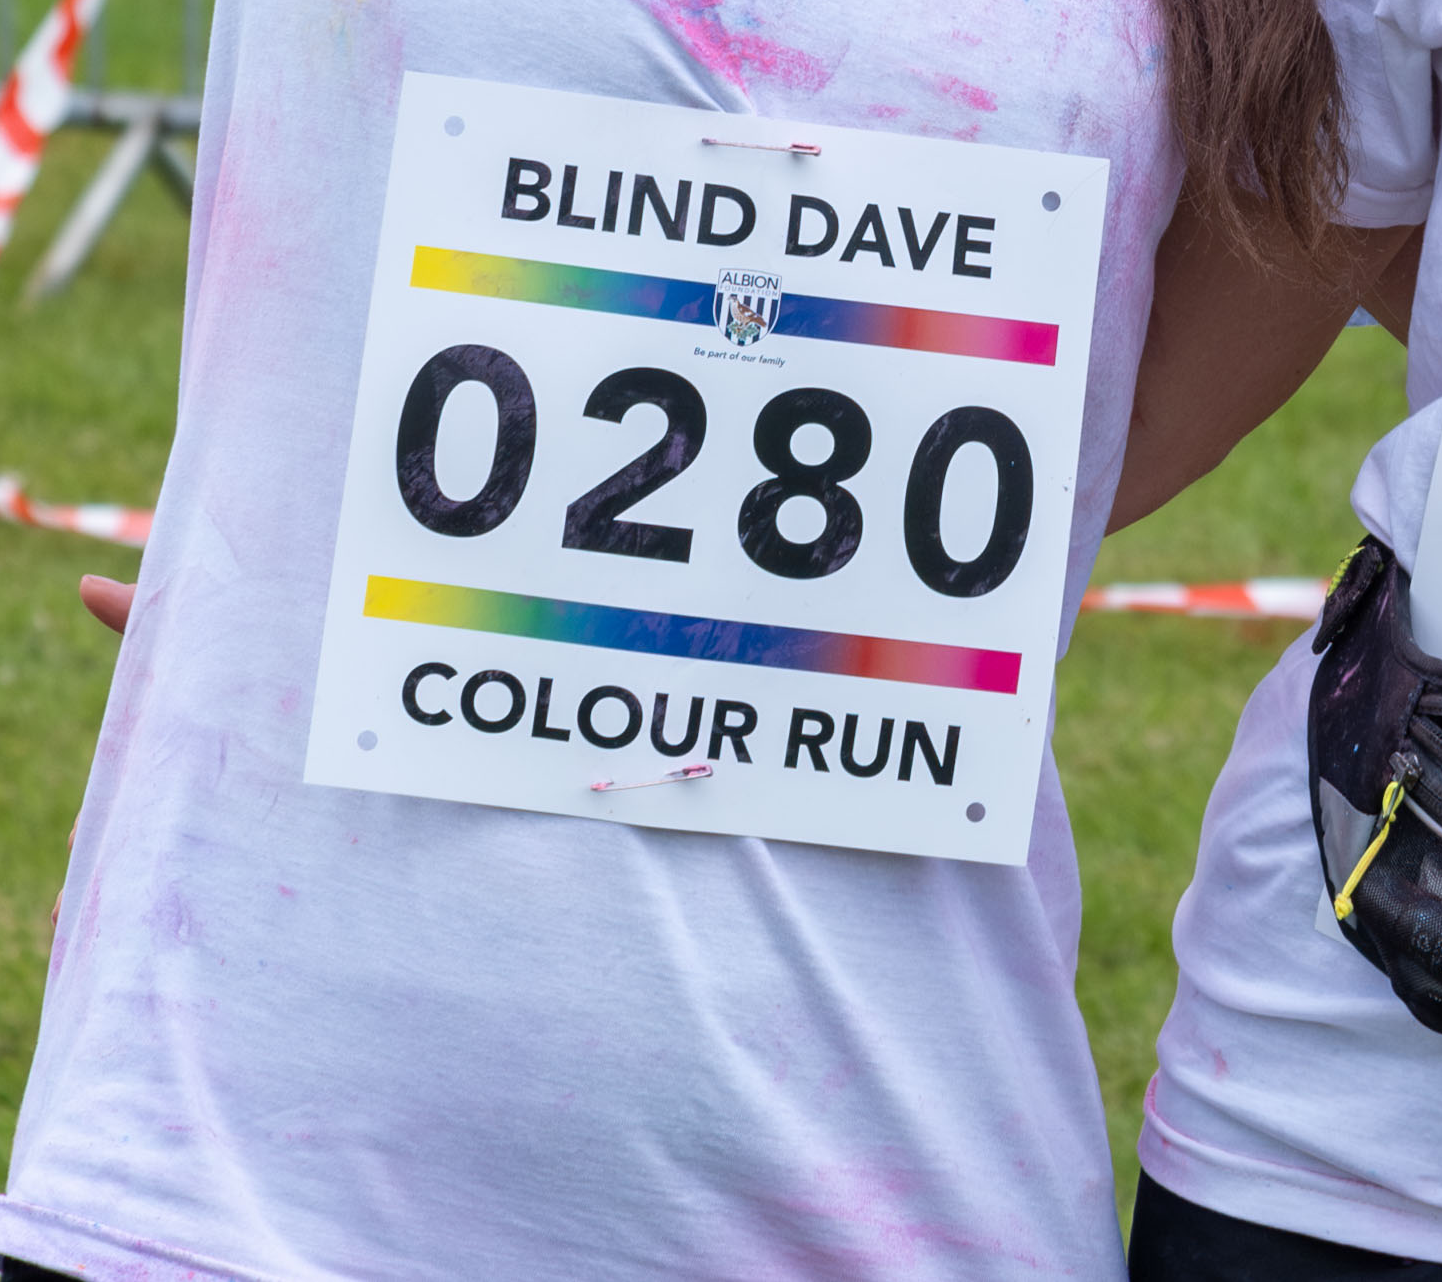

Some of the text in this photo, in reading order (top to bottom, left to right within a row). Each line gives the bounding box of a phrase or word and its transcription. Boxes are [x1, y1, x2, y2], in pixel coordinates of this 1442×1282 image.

[501, 157, 996, 279] BLIND DAVE
[721, 271, 779, 290] ALBION
[693, 346, 786, 369] Be part of our family
[396, 343, 1035, 599] 0280
[401, 661, 962, 787] COLOUR RUN
